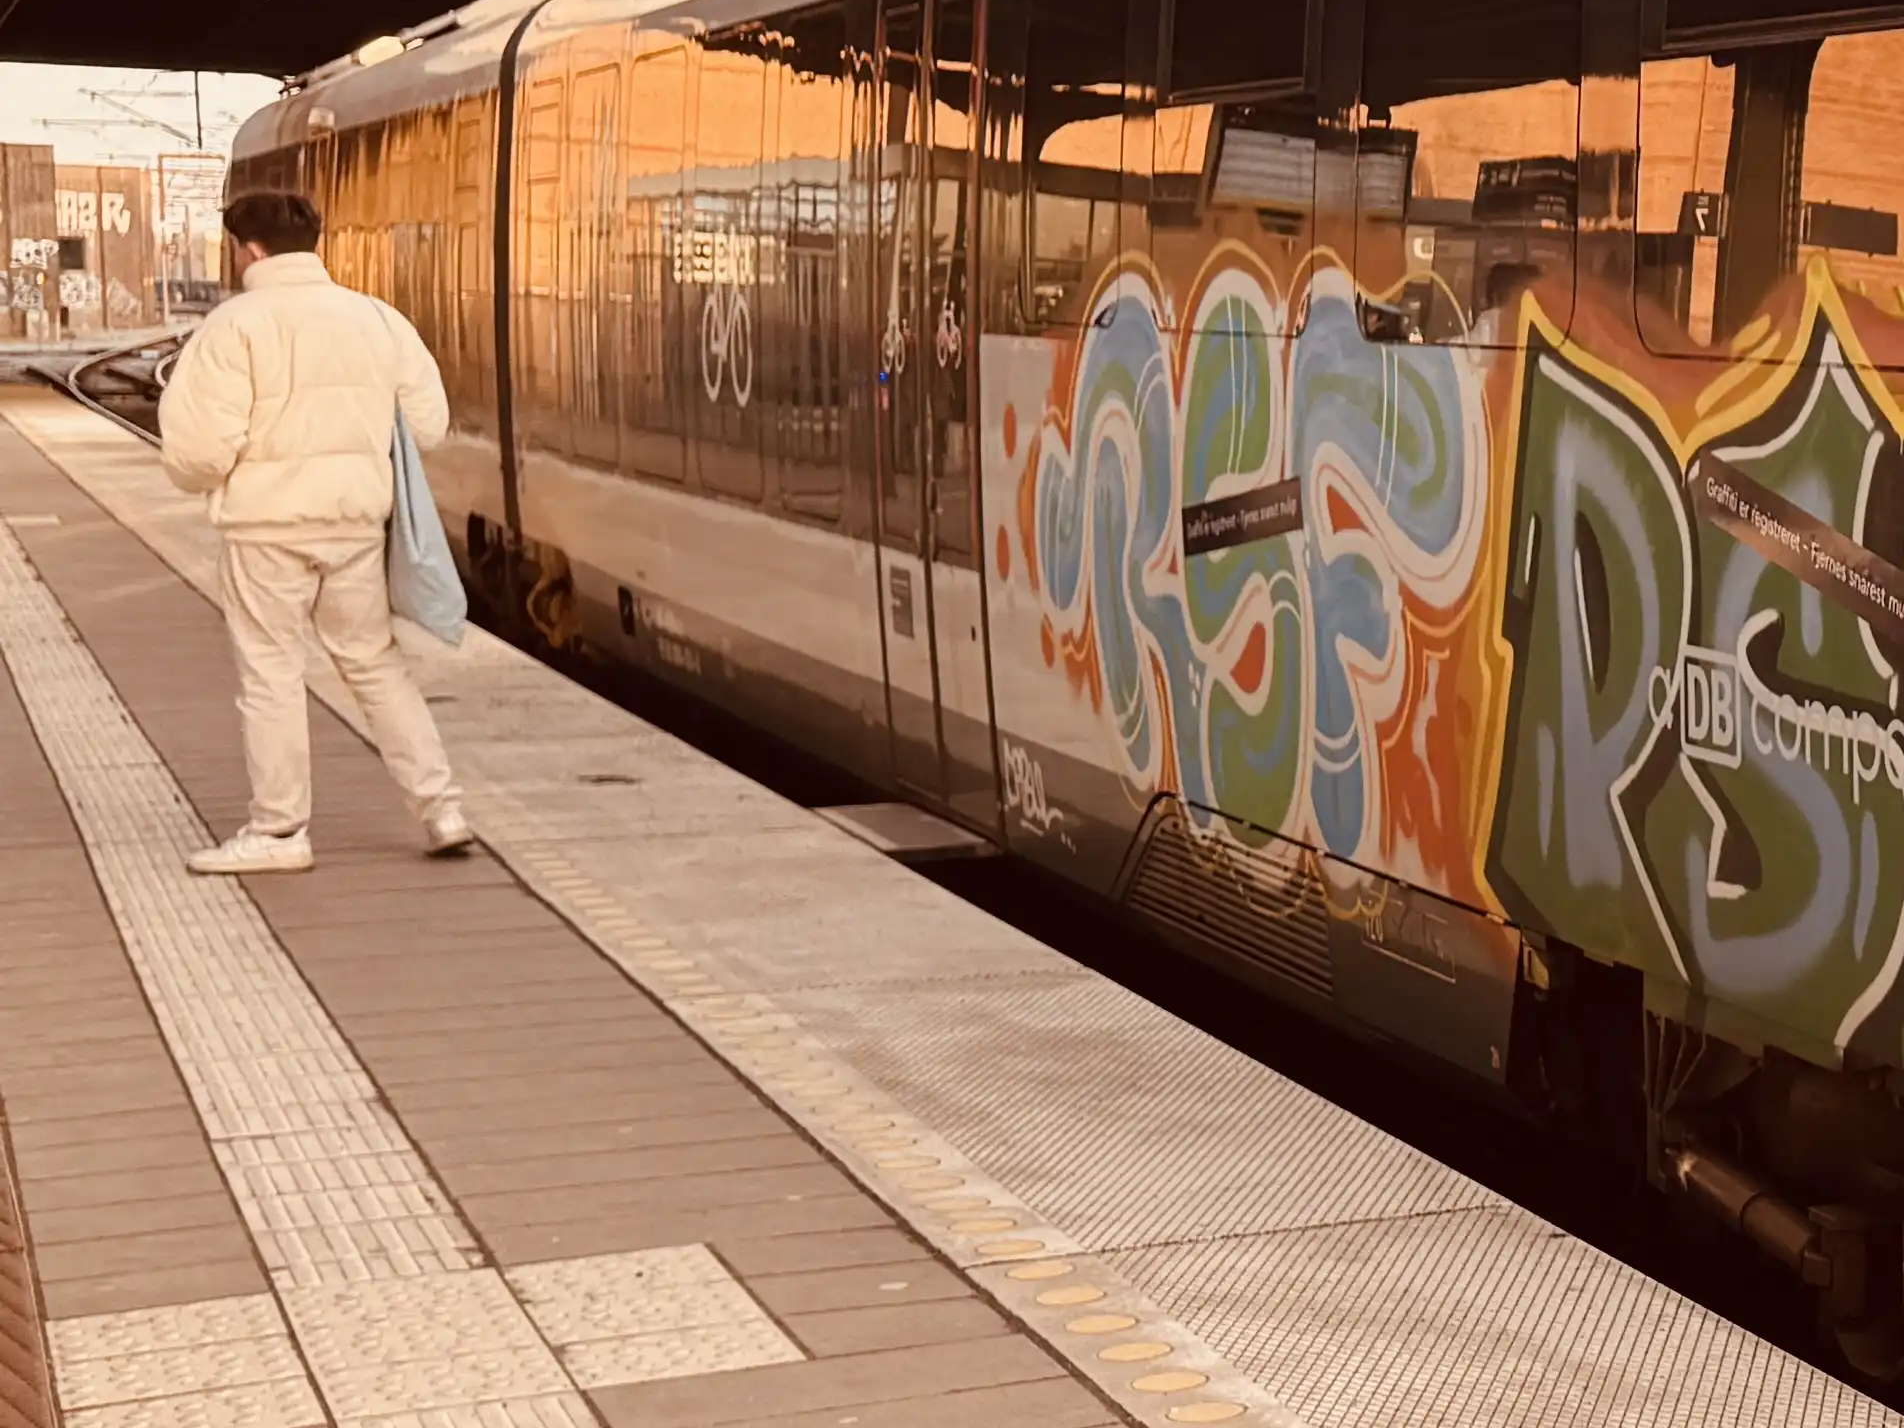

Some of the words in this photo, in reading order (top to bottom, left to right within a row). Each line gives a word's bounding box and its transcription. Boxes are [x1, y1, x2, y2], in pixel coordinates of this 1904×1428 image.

[1706, 476, 1738, 513] Graffiti
[1738, 501, 1749, 519] er
[1750, 503, 1801, 554] registreret
[1809, 539, 1847, 583] Fjernes
[1649, 665, 1674, 730] a
[1685, 661, 1738, 749] DB
